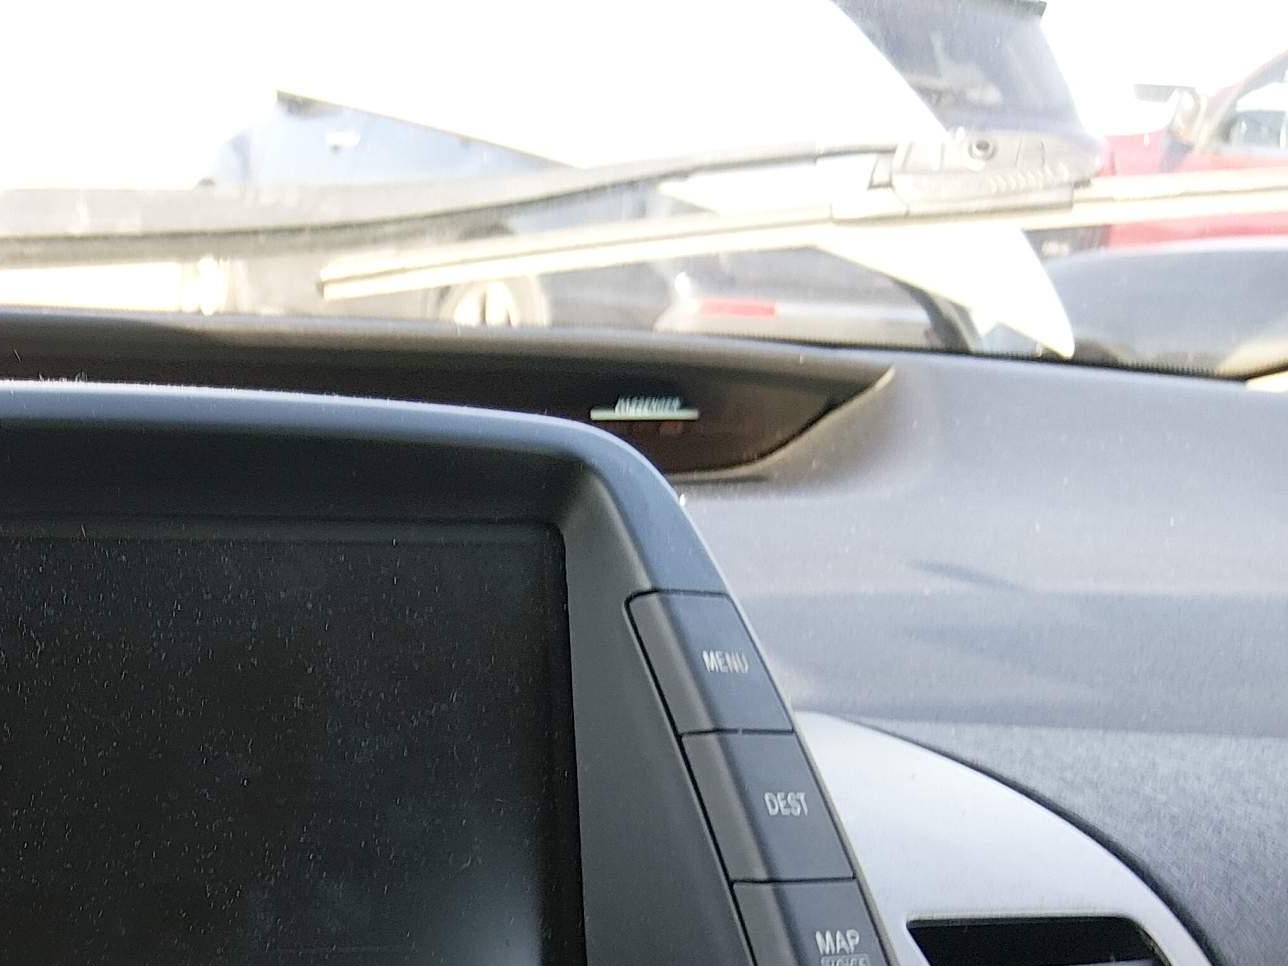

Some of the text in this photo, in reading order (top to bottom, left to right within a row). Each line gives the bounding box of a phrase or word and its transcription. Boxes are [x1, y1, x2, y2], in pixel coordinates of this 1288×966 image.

[702, 649, 749, 674] MENU
[764, 791, 809, 817] DEST
[815, 928, 860, 955] MAP
